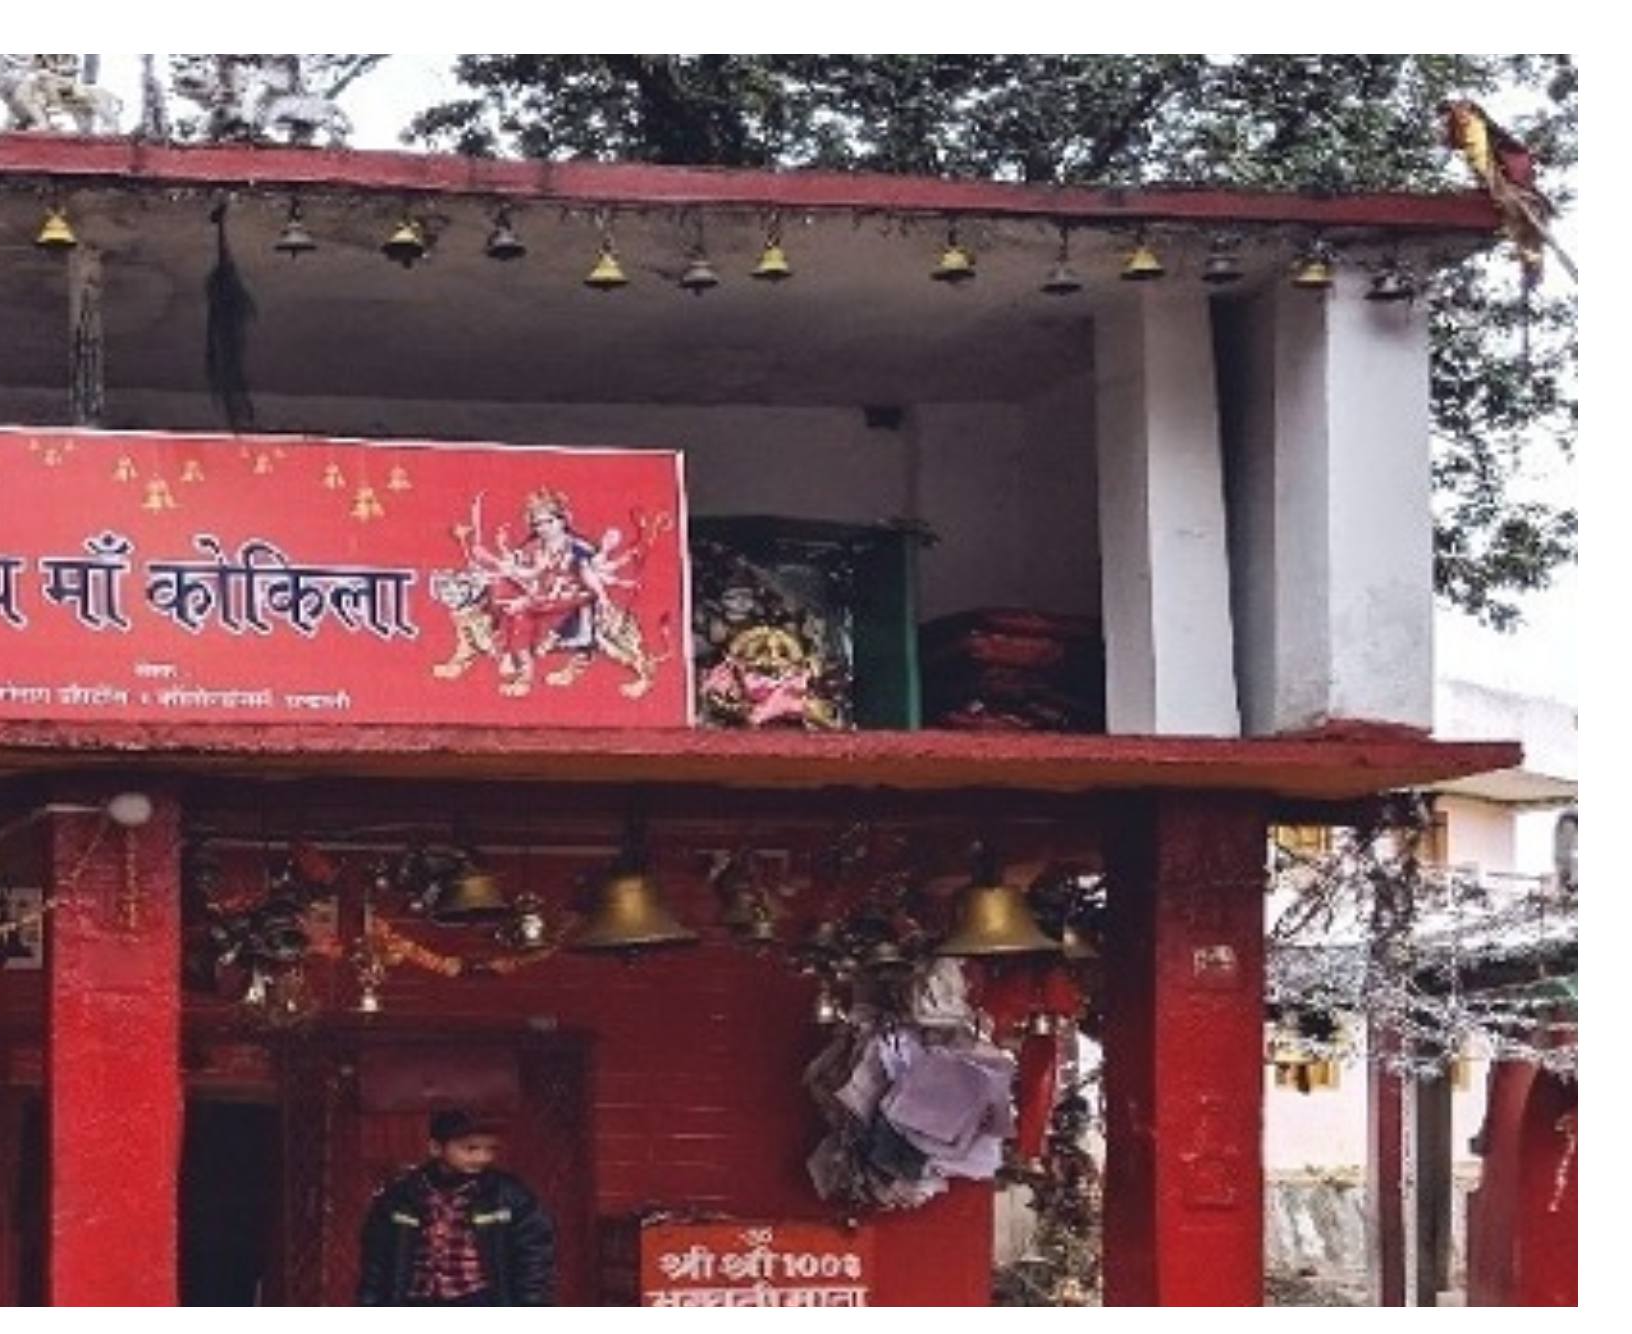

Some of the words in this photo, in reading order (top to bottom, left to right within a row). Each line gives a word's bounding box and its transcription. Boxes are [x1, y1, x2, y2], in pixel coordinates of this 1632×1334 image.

[39, 531, 130, 633] माँ
[143, 535, 419, 638] कोकिला
[658, 1244, 715, 1280] श्री
[719, 1246, 780, 1280] श्री
